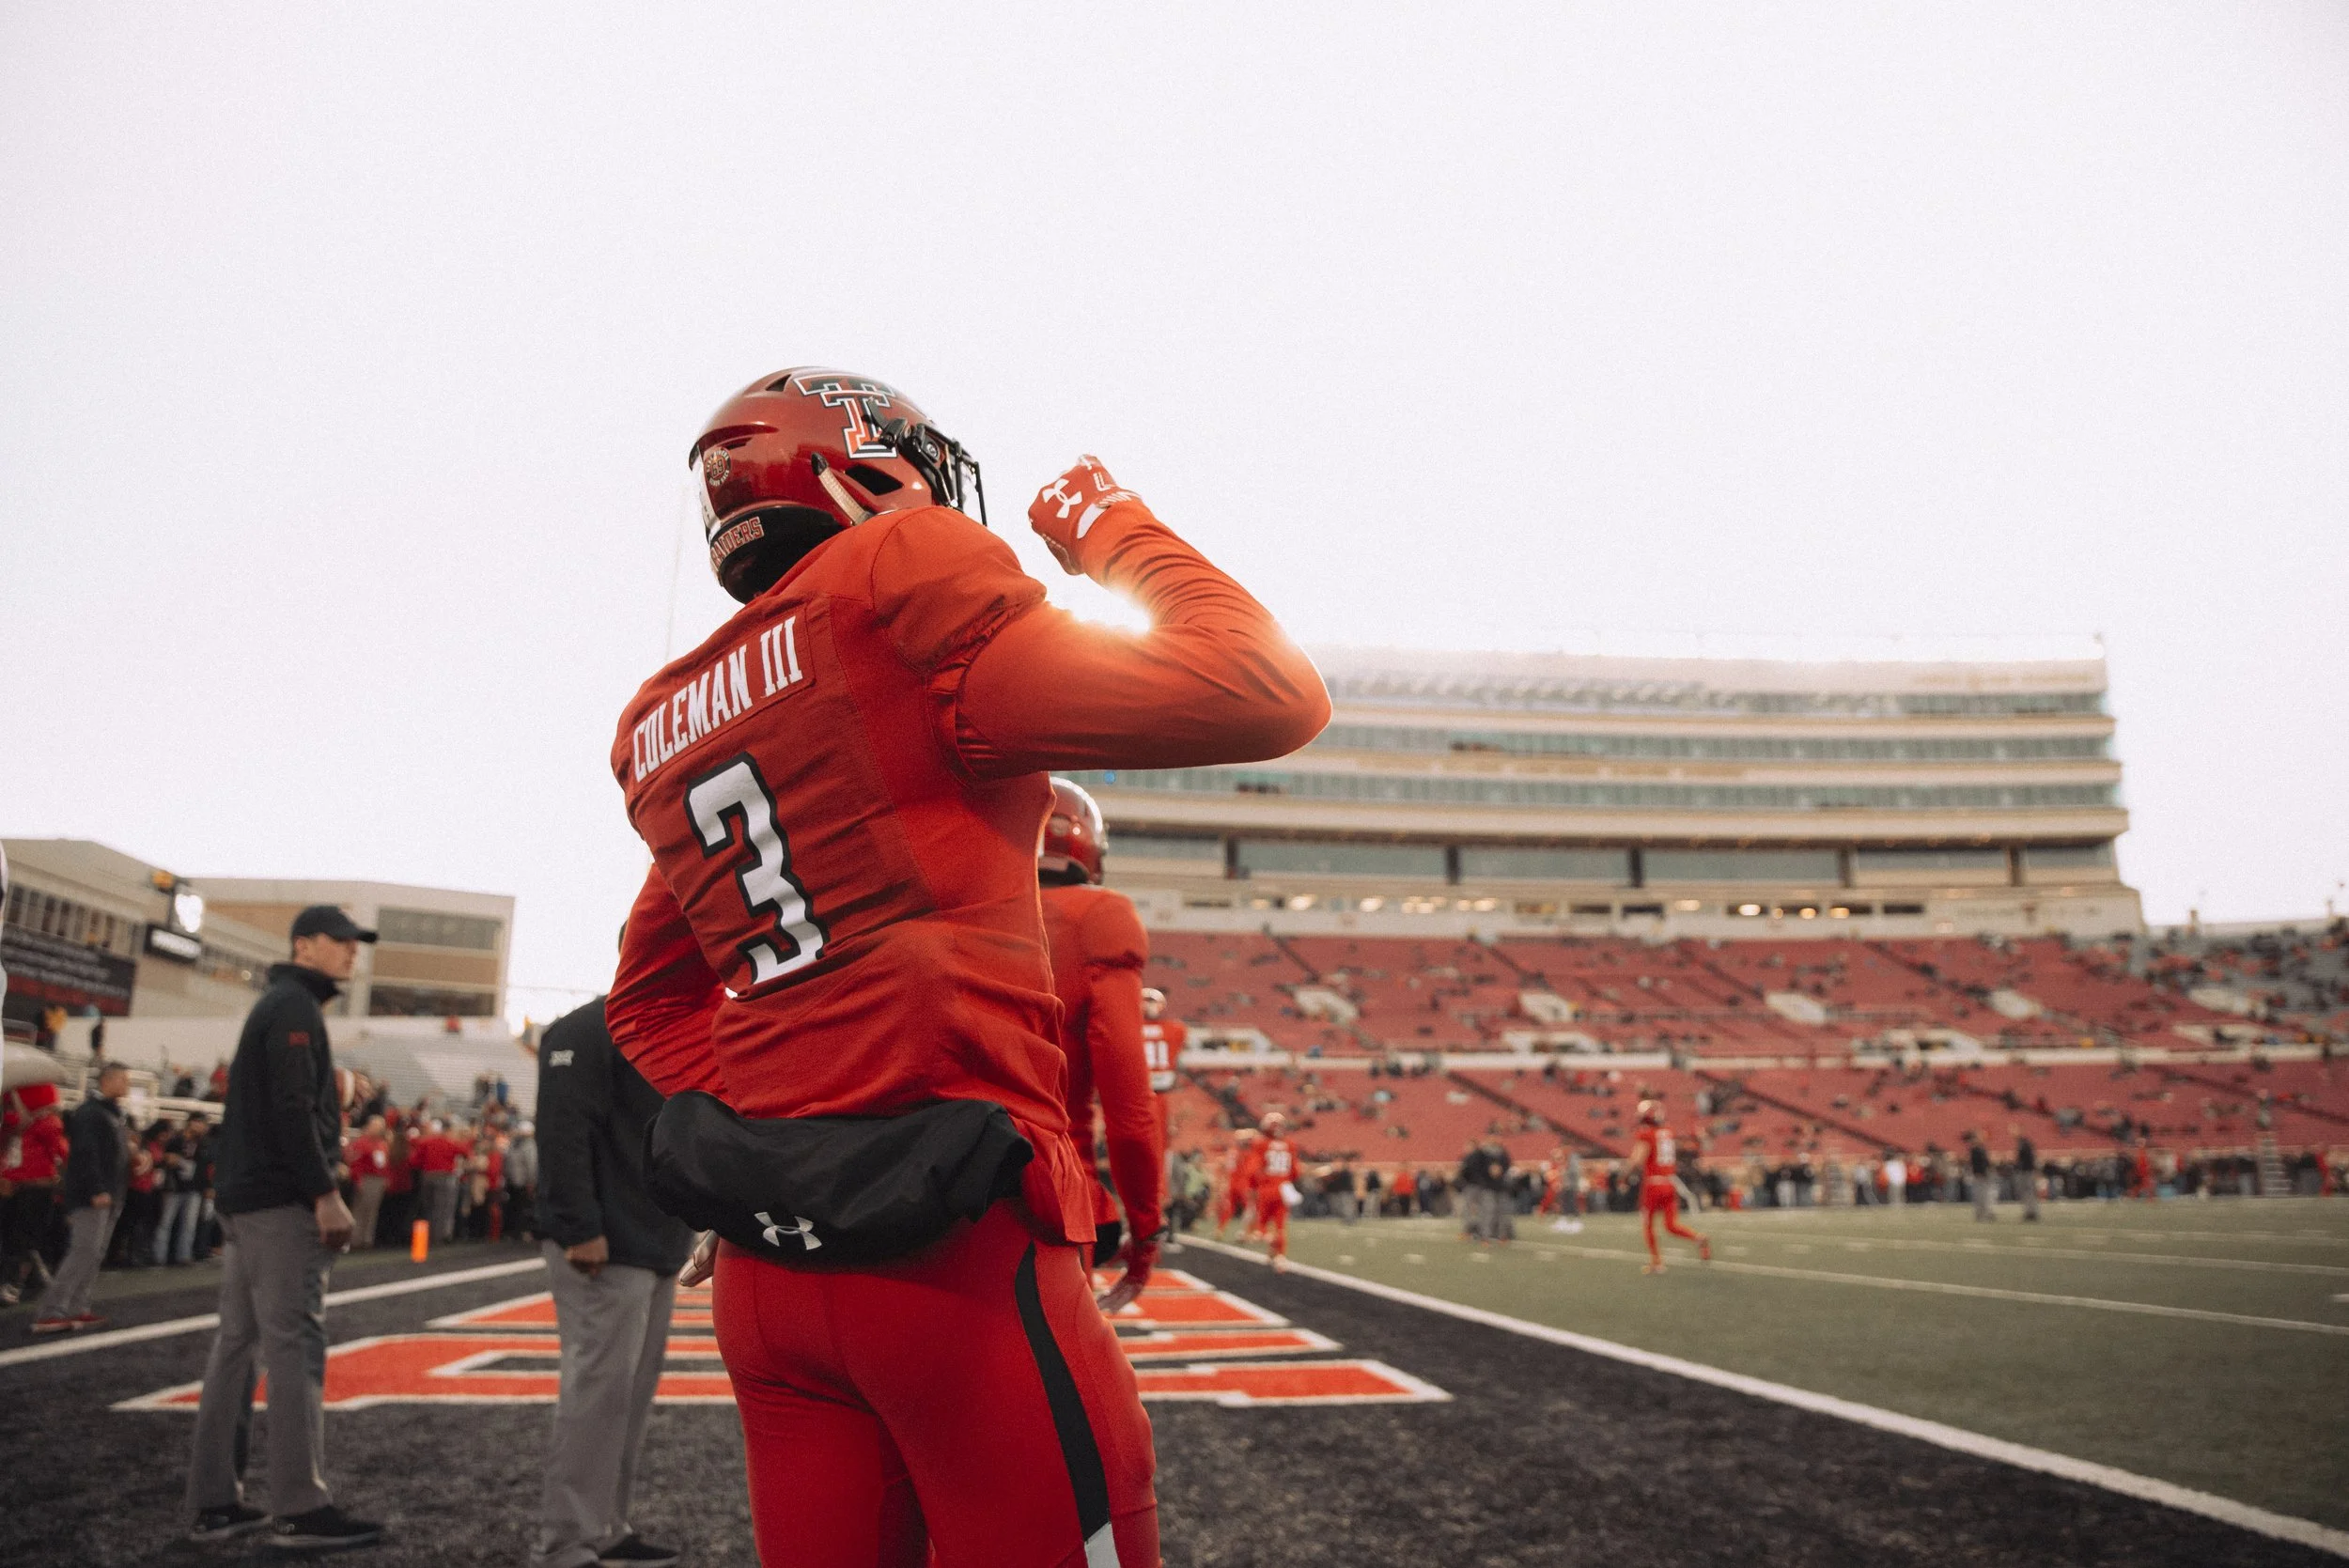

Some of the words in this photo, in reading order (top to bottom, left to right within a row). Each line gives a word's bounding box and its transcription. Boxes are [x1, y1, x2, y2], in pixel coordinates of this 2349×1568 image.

[633, 644, 753, 783] COLEMAN
[760, 615, 802, 698] III
[683, 752, 830, 985] 3
